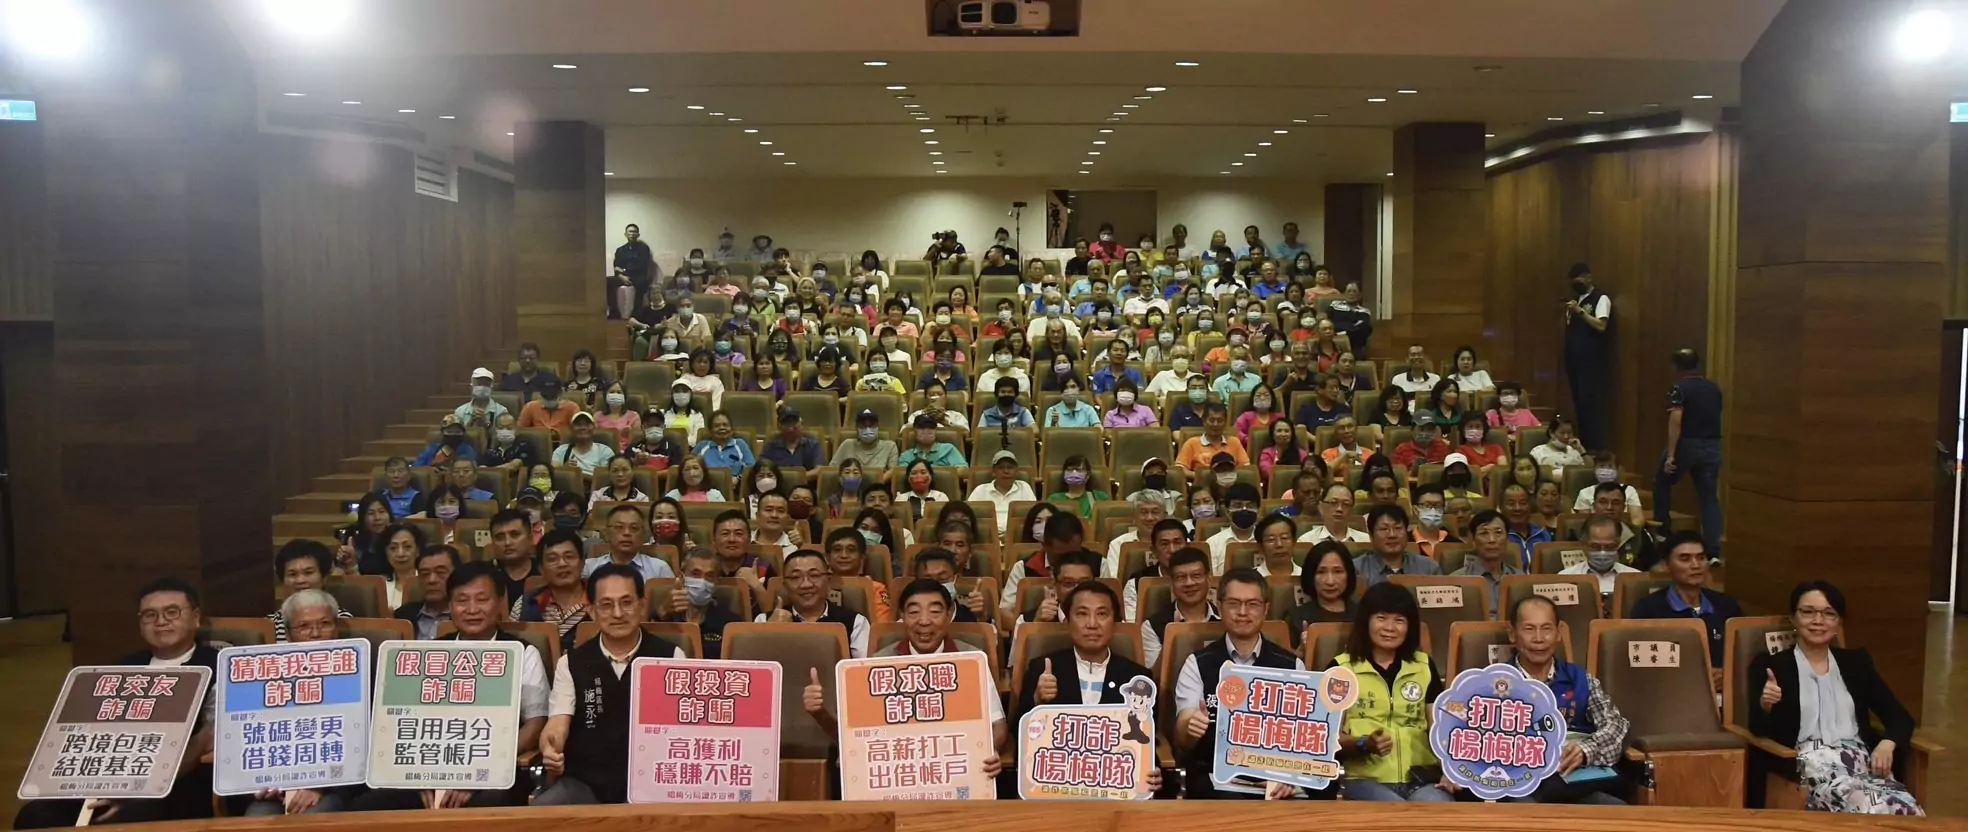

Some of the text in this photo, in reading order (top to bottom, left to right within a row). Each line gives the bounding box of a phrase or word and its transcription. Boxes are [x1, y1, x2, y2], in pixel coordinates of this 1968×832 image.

[230, 649, 357, 682] 猜猜我是誰
[395, 651, 506, 676] 假冒公署
[93, 674, 179, 696] 假交友
[265, 678, 323, 706] 詐騙
[422, 678, 477, 703] 詐騙
[665, 669, 750, 696] 假投資
[870, 664, 957, 695] 假求職
[97, 698, 156, 720] 詐騙
[678, 698, 735, 723] 詐騙
[886, 693, 943, 722] 詐騙
[1250, 679, 1316, 717] 打詐
[1468, 696, 1533, 732] 打詐
[242, 716, 343, 745] 號碼變更
[397, 718, 492, 741] 冒用身分
[1054, 714, 1120, 750] 打詐
[1229, 712, 1328, 755] 楊梅隊
[61, 733, 164, 754] 跨境包裹
[241, 741, 344, 770] 借錢周轉
[394, 743, 490, 765] 監管帳戶
[668, 738, 741, 761] 高獲利
[867, 735, 967, 762] 高薪打工
[1449, 728, 1547, 768] 楊梅隊
[51, 755, 155, 777] 結婚基金
[654, 762, 753, 786] 穩賺不賠
[869, 759, 968, 789] 出借帳戶
[1034, 749, 1134, 788] 楊梅隊
